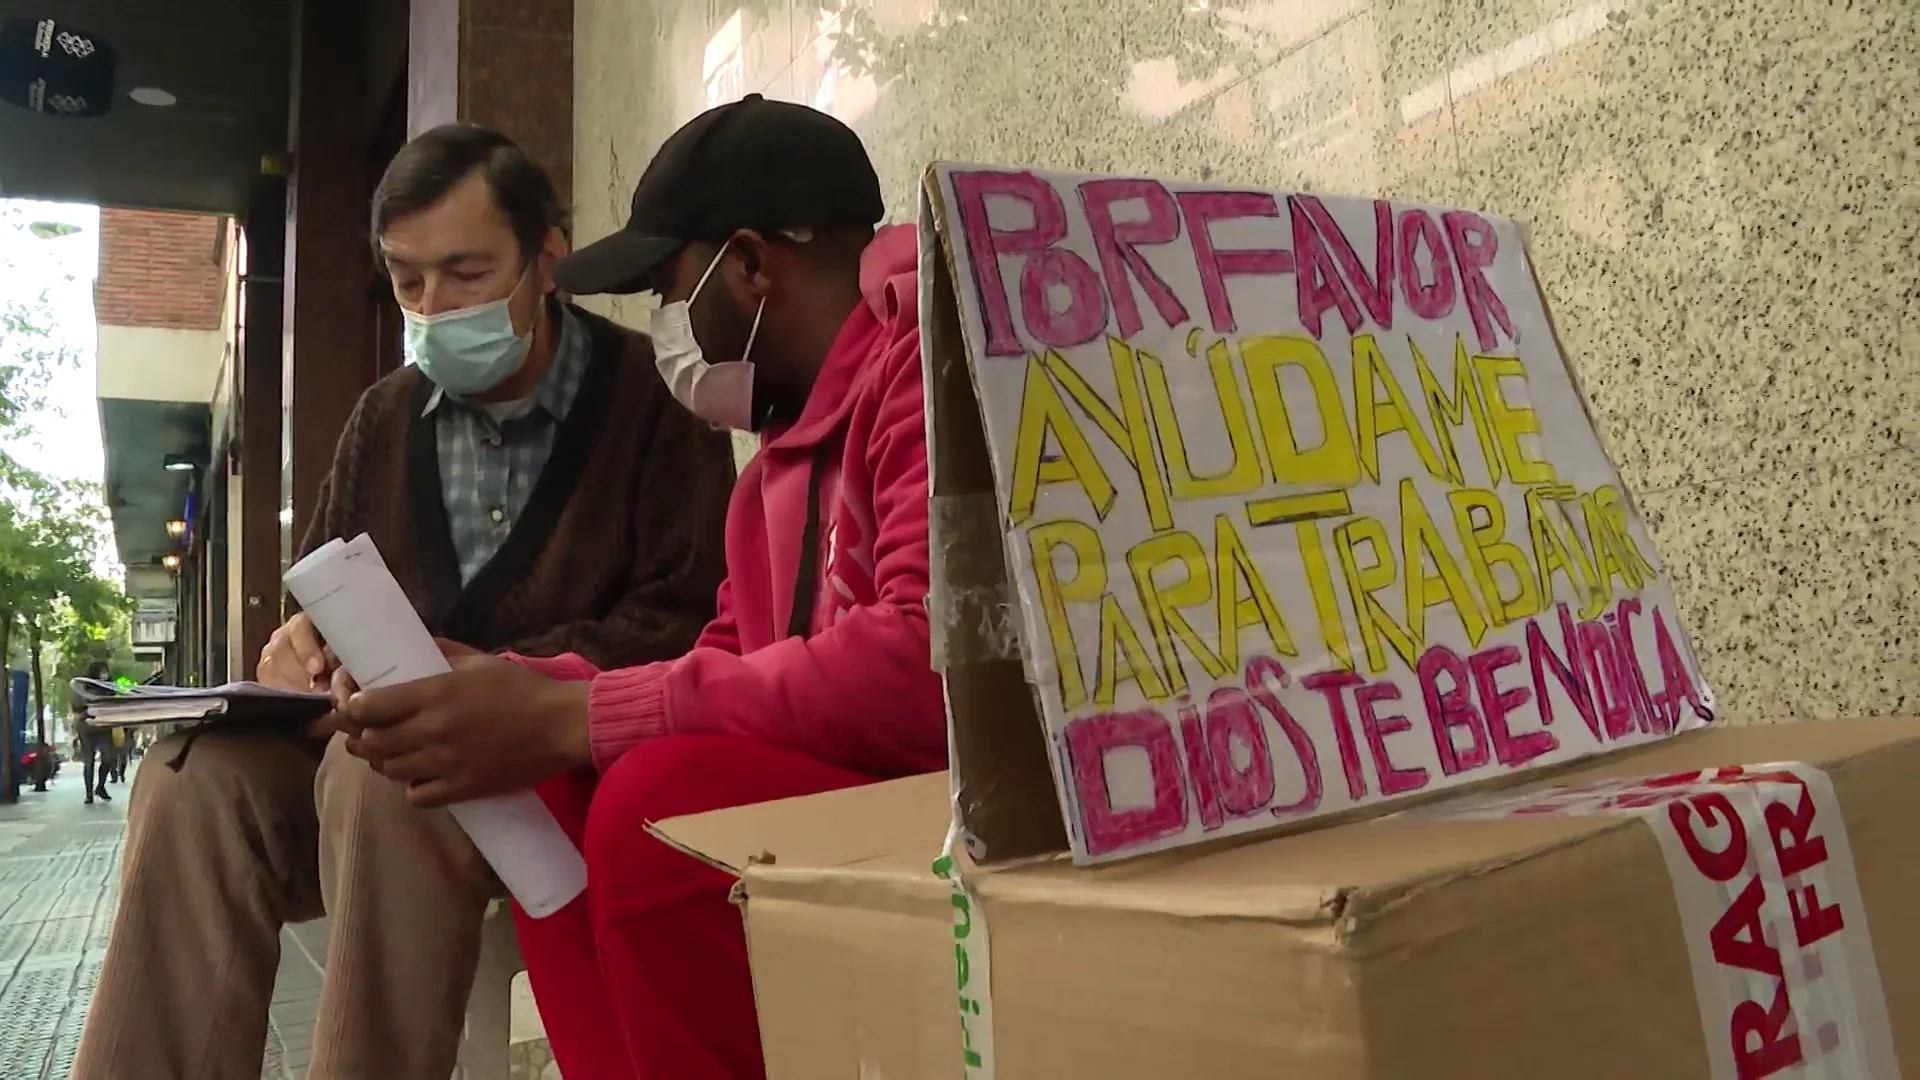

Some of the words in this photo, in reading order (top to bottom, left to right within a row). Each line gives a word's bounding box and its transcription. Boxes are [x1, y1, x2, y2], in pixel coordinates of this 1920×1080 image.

[951, 170, 1189, 356] POR
[1174, 190, 1521, 351] FAVOR
[1027, 513, 1298, 713] PARA
[1249, 478, 1658, 678] TRABAJAR
[1064, 655, 1324, 856] DIOS
[1301, 668, 1428, 800] TE
